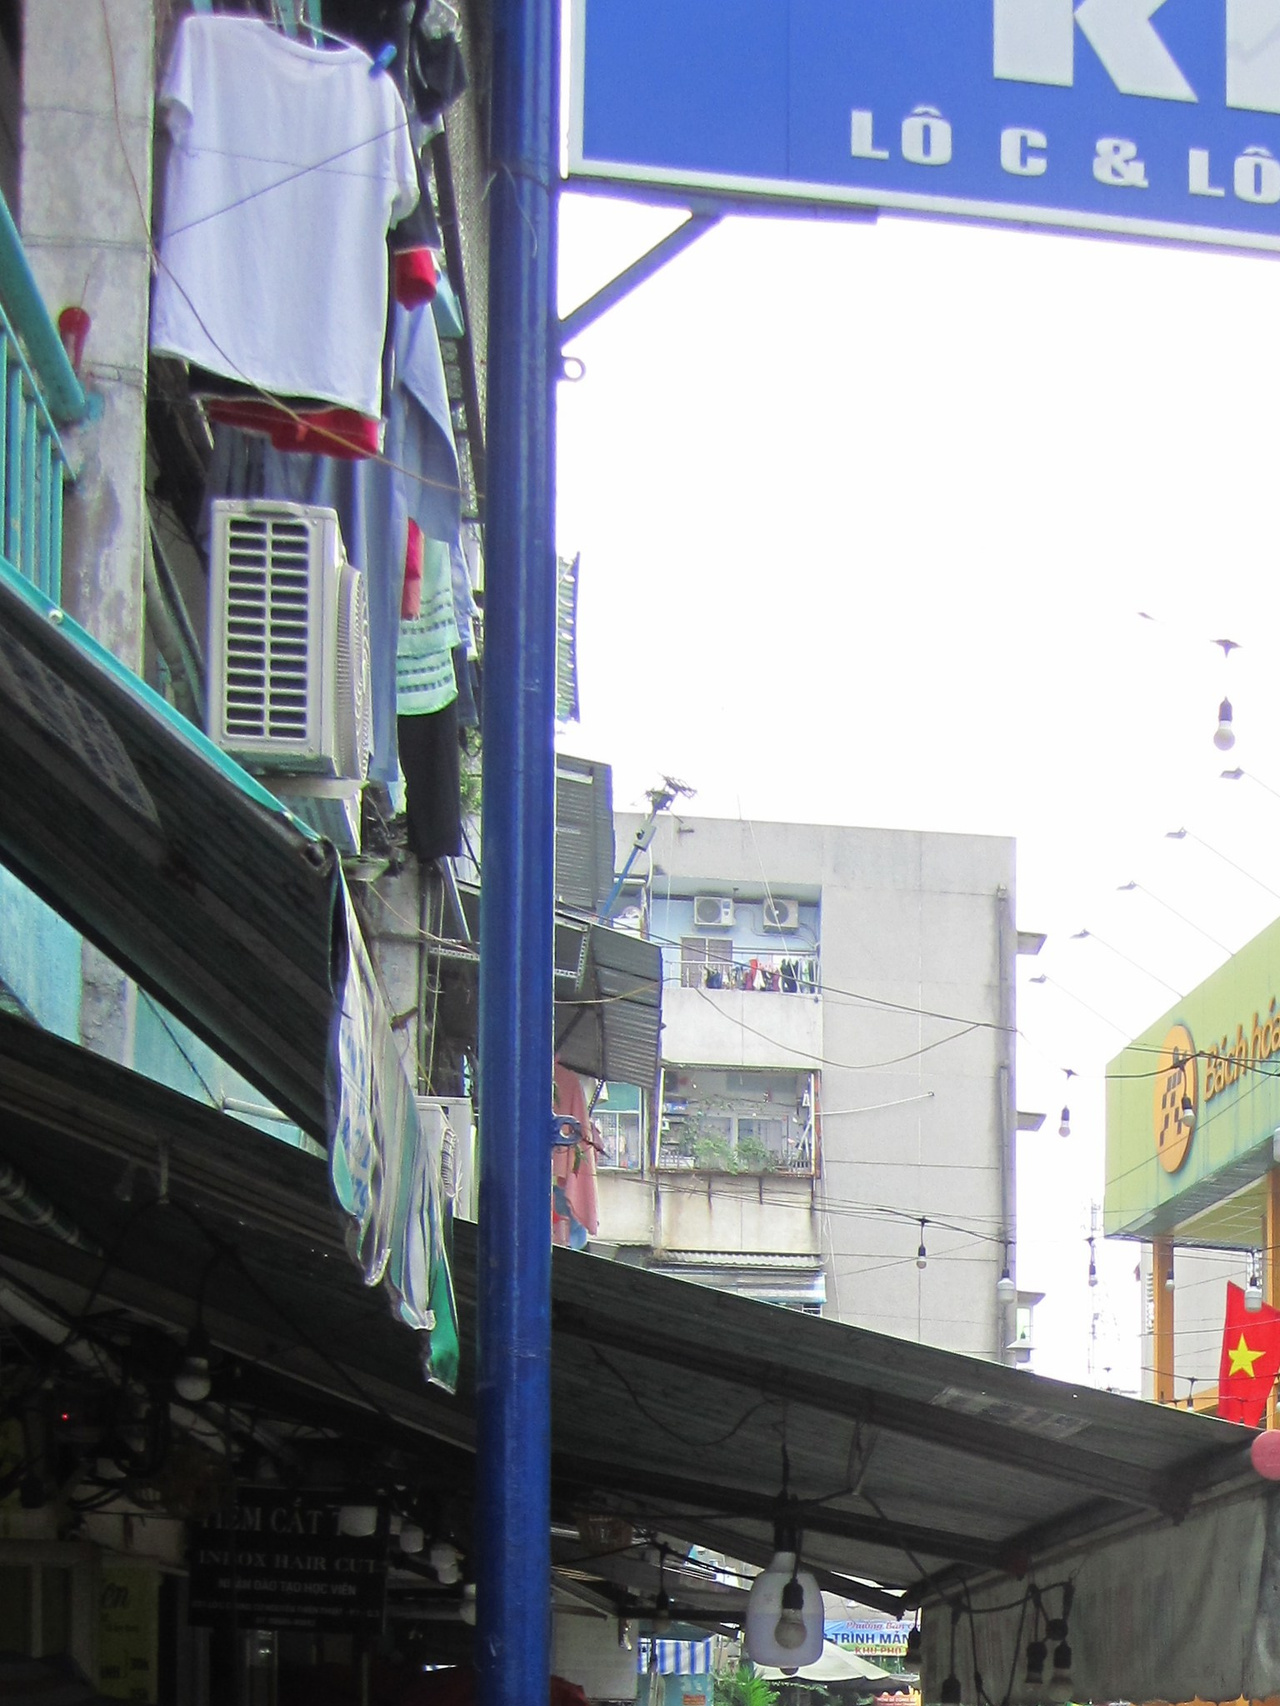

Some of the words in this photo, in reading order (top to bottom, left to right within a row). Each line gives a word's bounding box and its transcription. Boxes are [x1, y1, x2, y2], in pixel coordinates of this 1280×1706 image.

[851, 105, 952, 167] LÔ
[1000, 127, 1047, 177] C
[1093, 137, 1149, 189] &
[1189, 146, 1280, 204] LÔ
[1204, 1035, 1247, 1103] Bách
[274, 1554, 326, 1571] HAIR
